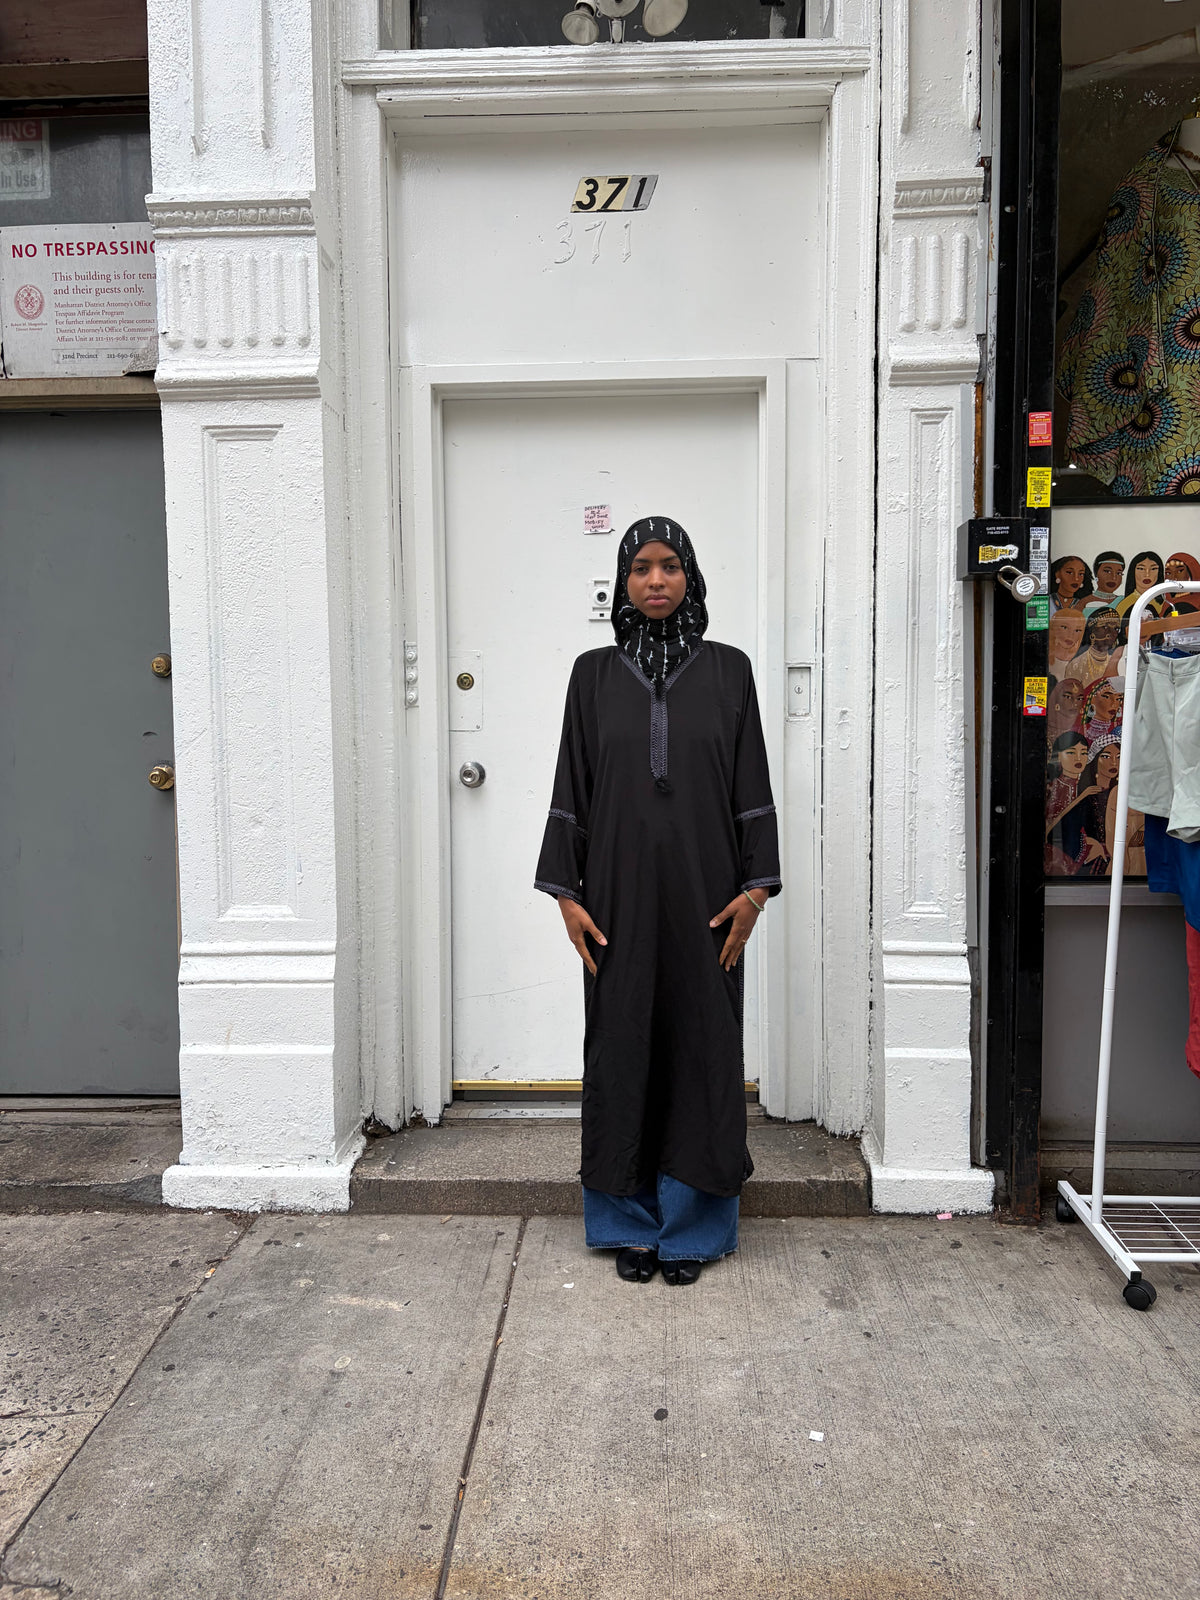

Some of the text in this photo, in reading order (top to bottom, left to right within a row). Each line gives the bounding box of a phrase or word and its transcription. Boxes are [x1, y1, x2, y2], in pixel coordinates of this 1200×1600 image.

[16, 170, 37, 187] Use
[575, 177, 648, 211] 371
[553, 218, 633, 265] 371
[11, 243, 37, 258] NO
[52, 272, 72, 282] This
[74, 271, 111, 283] building
[113, 271, 121, 280] is
[123, 270, 136, 280] for
[53, 284, 145, 296] and their guests only.
[106, 301, 133, 309] Attorney's
[118, 318, 135, 326] please
[78, 326, 104, 334] Attorney's
[122, 326, 156, 334] Community
